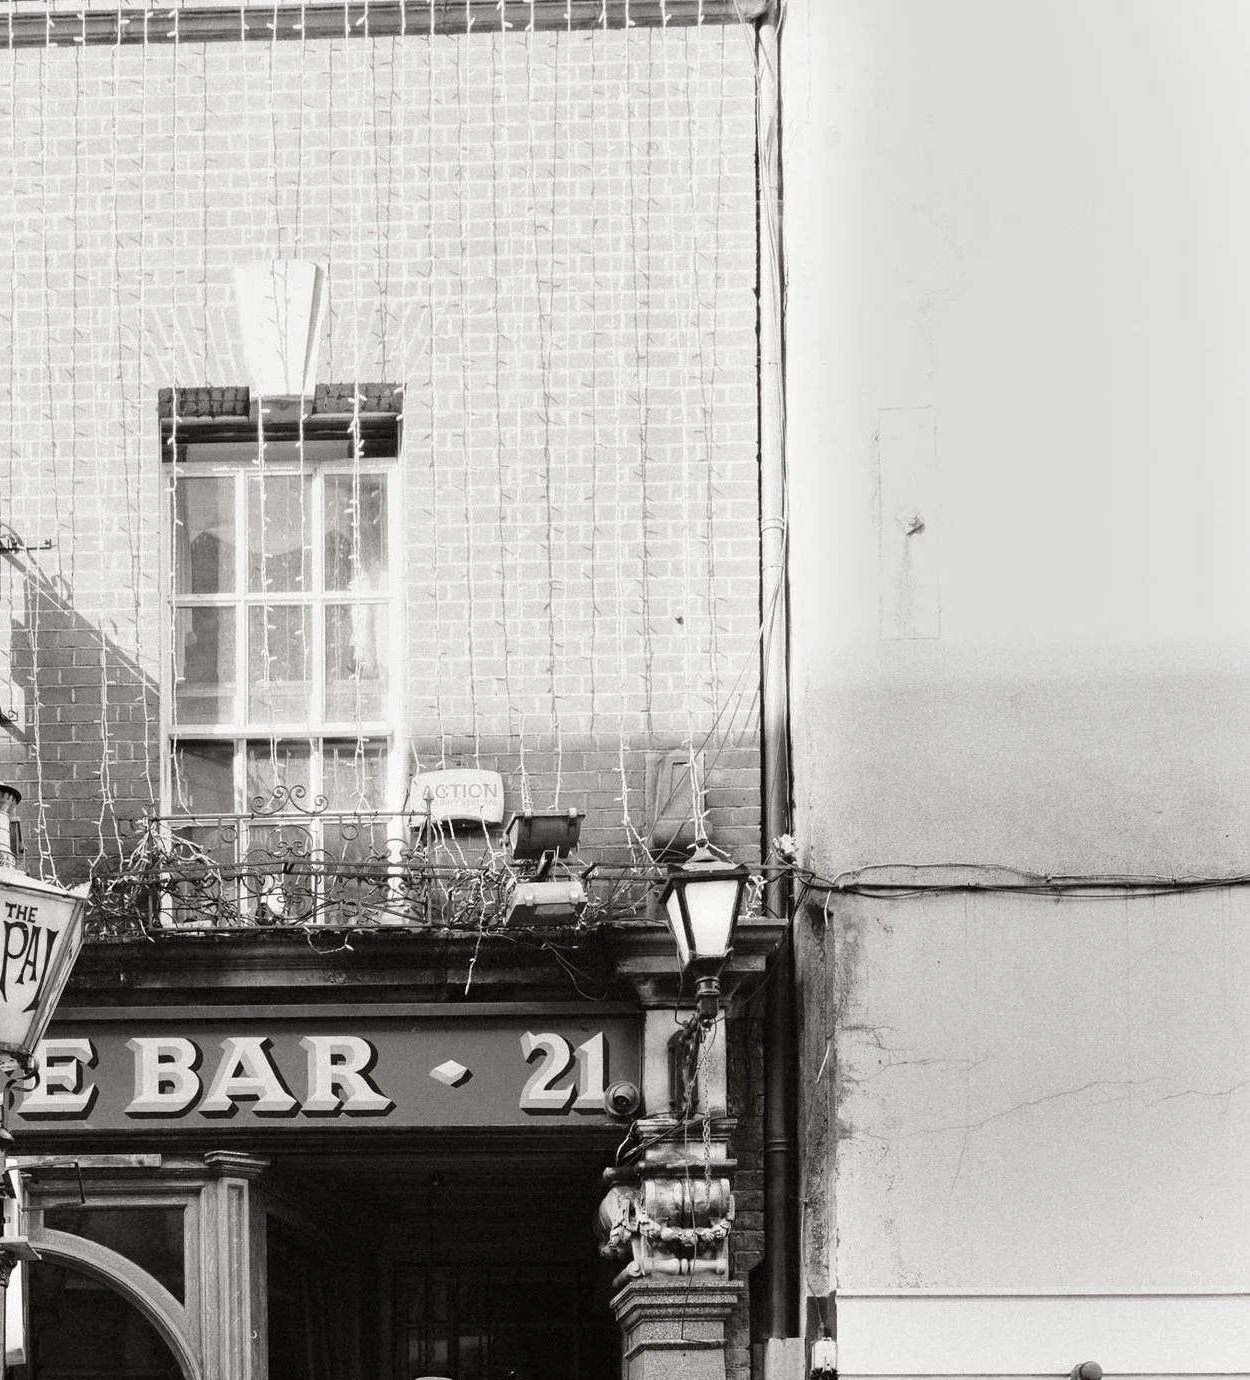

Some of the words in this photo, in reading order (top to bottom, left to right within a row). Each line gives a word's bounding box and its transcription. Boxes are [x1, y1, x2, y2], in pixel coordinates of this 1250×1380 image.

[426, 783, 497, 799] CTION
[5, 901, 38, 923] THE
[124, 1035, 395, 1120] BAR
[518, 1031, 609, 1115] 21
